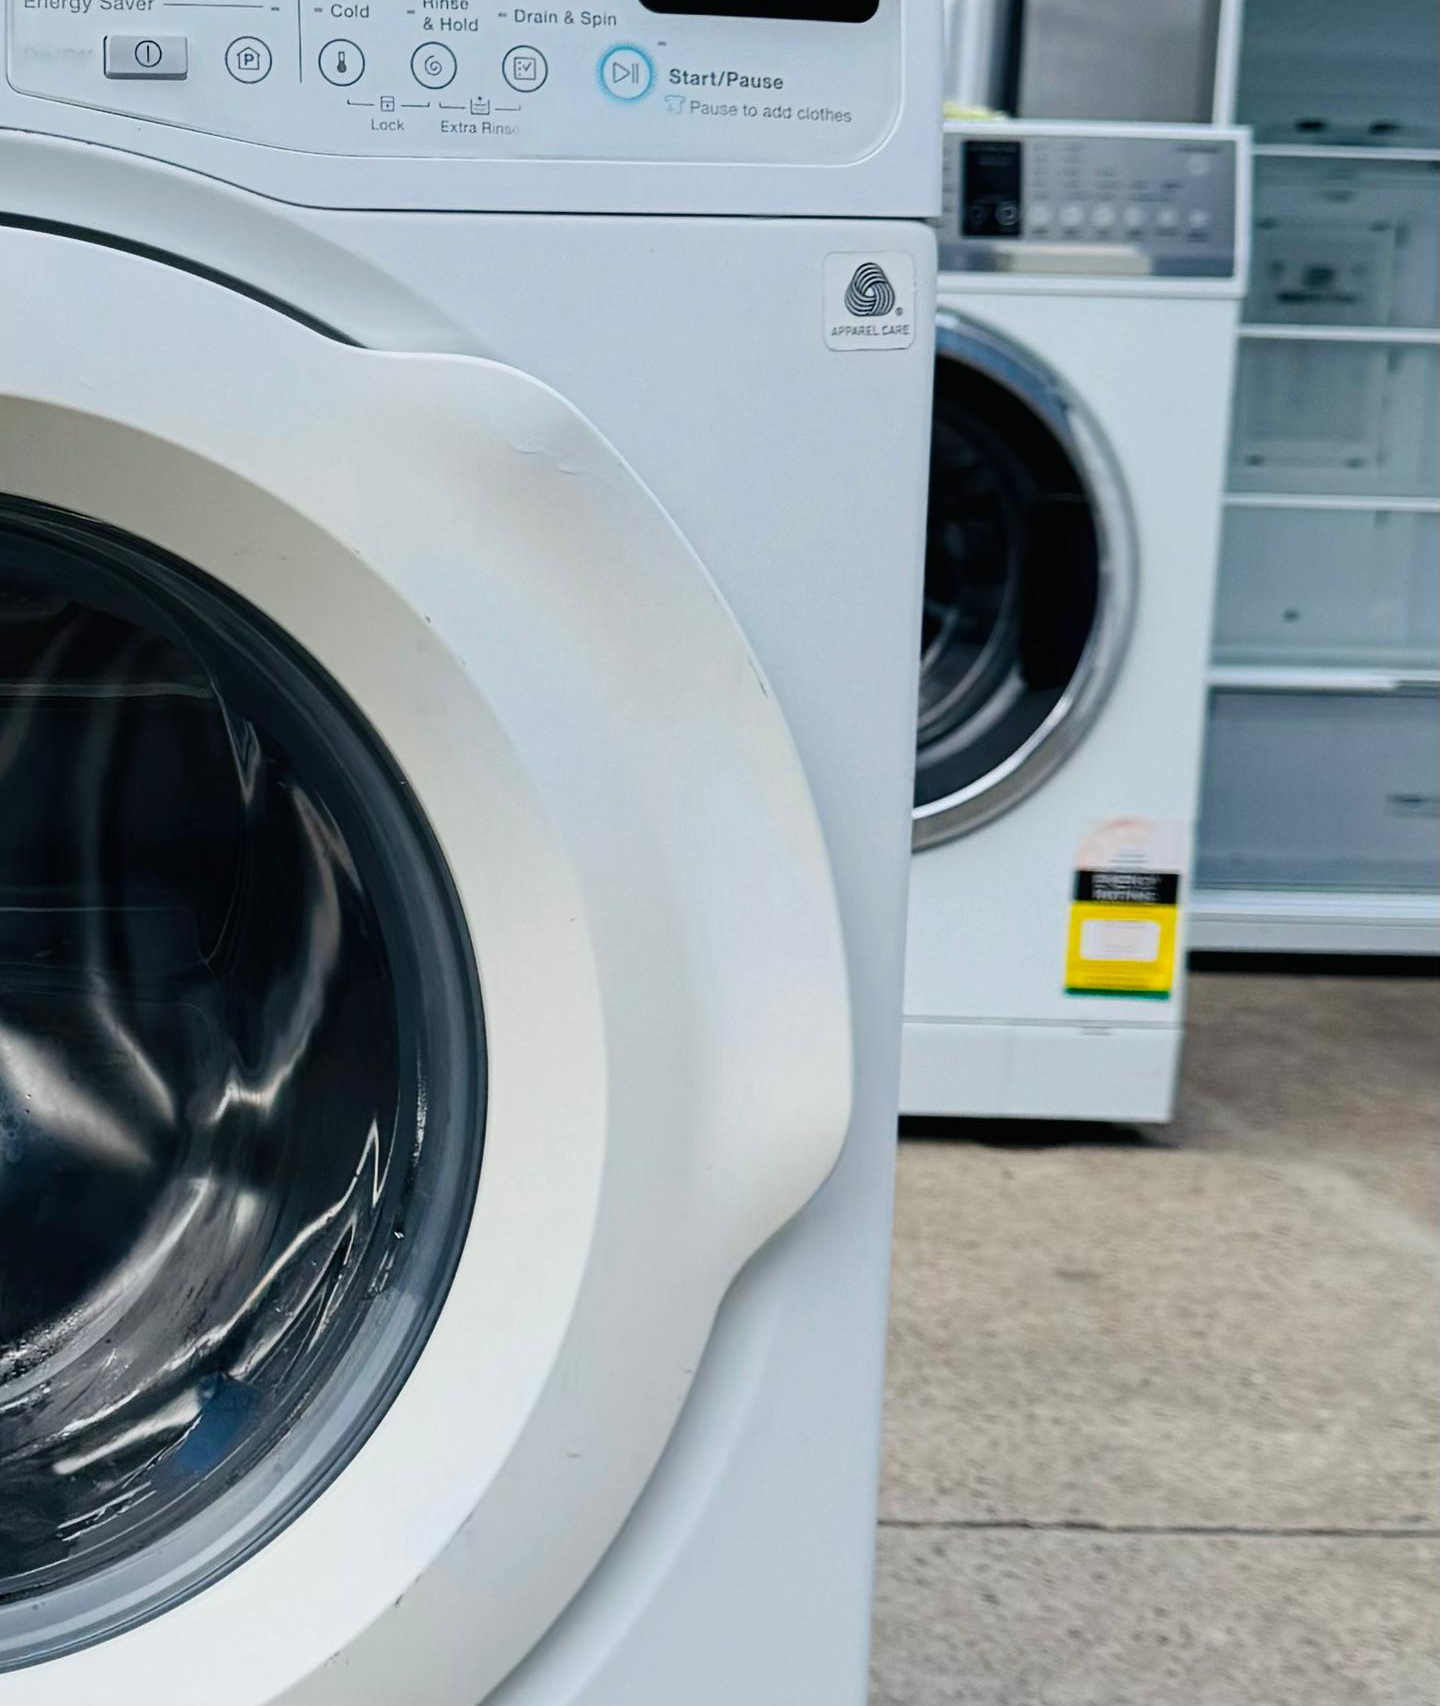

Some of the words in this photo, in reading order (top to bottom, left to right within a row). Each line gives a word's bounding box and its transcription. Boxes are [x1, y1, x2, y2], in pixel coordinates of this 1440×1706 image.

[330, 4, 370, 19] Cold
[514, 10, 558, 25] Drain
[563, 11, 575, 26] &
[580, 11, 618, 28] Spin
[423, 17, 434, 32] &
[440, 17, 479, 33] Hold
[669, 68, 784, 90] Start/Pause
[689, 100, 738, 117] Pause
[743, 104, 758, 117] to
[762, 105, 792, 120] add
[797, 107, 852, 123] clothes
[370, 118, 405, 133] Lock
[441, 120, 477, 134] Extra
[831, 325, 880, 337] APPAREL
[881, 324, 911, 337] CARE
